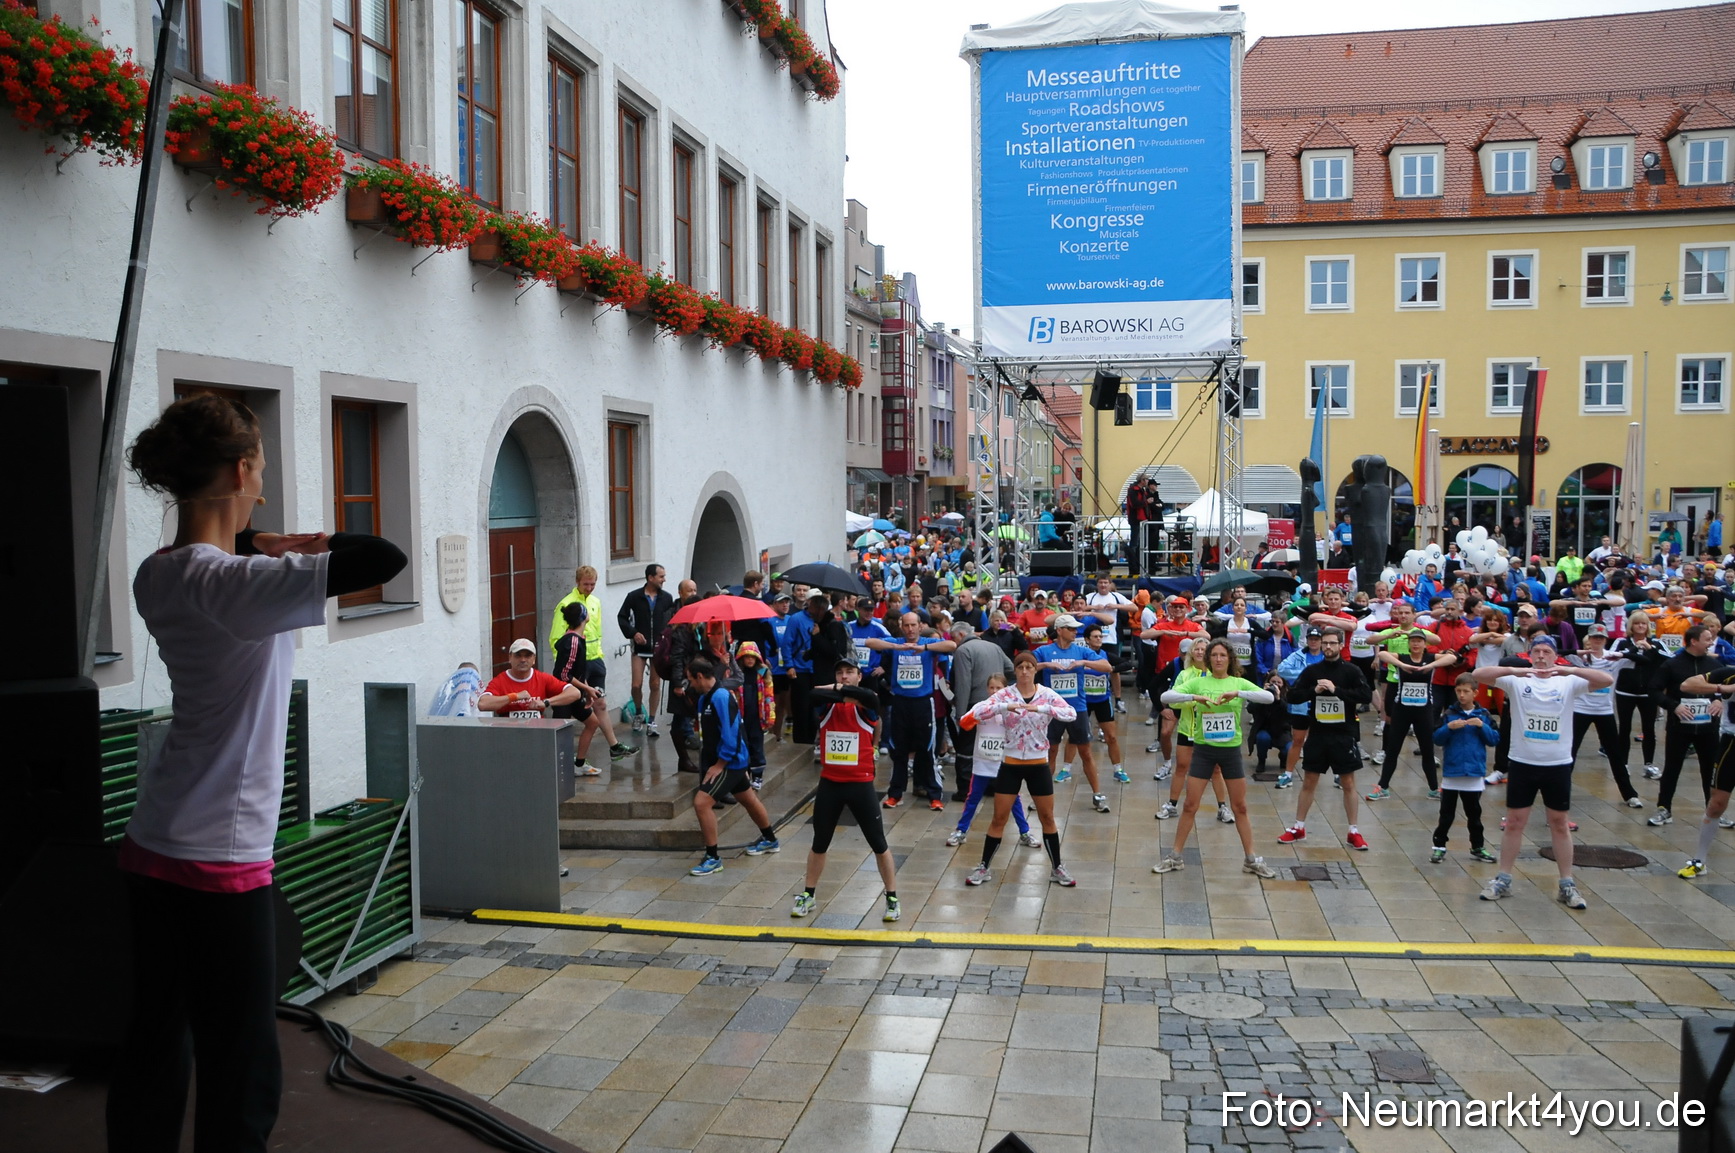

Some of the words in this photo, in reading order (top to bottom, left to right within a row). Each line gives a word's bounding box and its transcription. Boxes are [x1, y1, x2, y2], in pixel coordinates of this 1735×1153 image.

[1027, 62, 1181, 87] Messeauftritte
[1006, 84, 1146, 103] Hauptversammlungen
[1166, 84, 1201, 94] together
[1028, 107, 1065, 116] Tagungen
[1069, 100, 1164, 116] Roadshows
[1021, 114, 1188, 136] Sportveranstaltungen
[1006, 134, 1135, 156] Installationen
[1139, 137, 1205, 147] TV-Produktionen
[1020, 154, 1144, 169] Kulturveranstaltungen
[1040, 170, 1093, 179] Fashionshows
[1098, 166, 1188, 177] Produktpräsentationen
[1028, 179, 1177, 197] Firmeneröffnungen
[1047, 196, 1107, 206] Firmenjubiläum
[1105, 204, 1155, 212] Firmenfeiern
[1051, 213, 1144, 231] Kongresse
[1100, 229, 1139, 238] Musicals
[1060, 240, 1129, 254] Konzerte
[1046, 278, 1164, 291] www.barowski-ag.de
[1060, 318, 1153, 334] BAROWSKI
[1160, 317, 1184, 332] AG
[900, 670, 920, 680] 2768
[1054, 678, 1075, 688] 2776
[1085, 678, 1104, 688] 5173
[1404, 688, 1424, 697] 2229
[1321, 702, 1338, 712] 576
[1206, 719, 1232, 732] 2412
[1528, 718, 1558, 732] 3180
[831, 740, 852, 752] 337
[982, 740, 1004, 750] 4024
